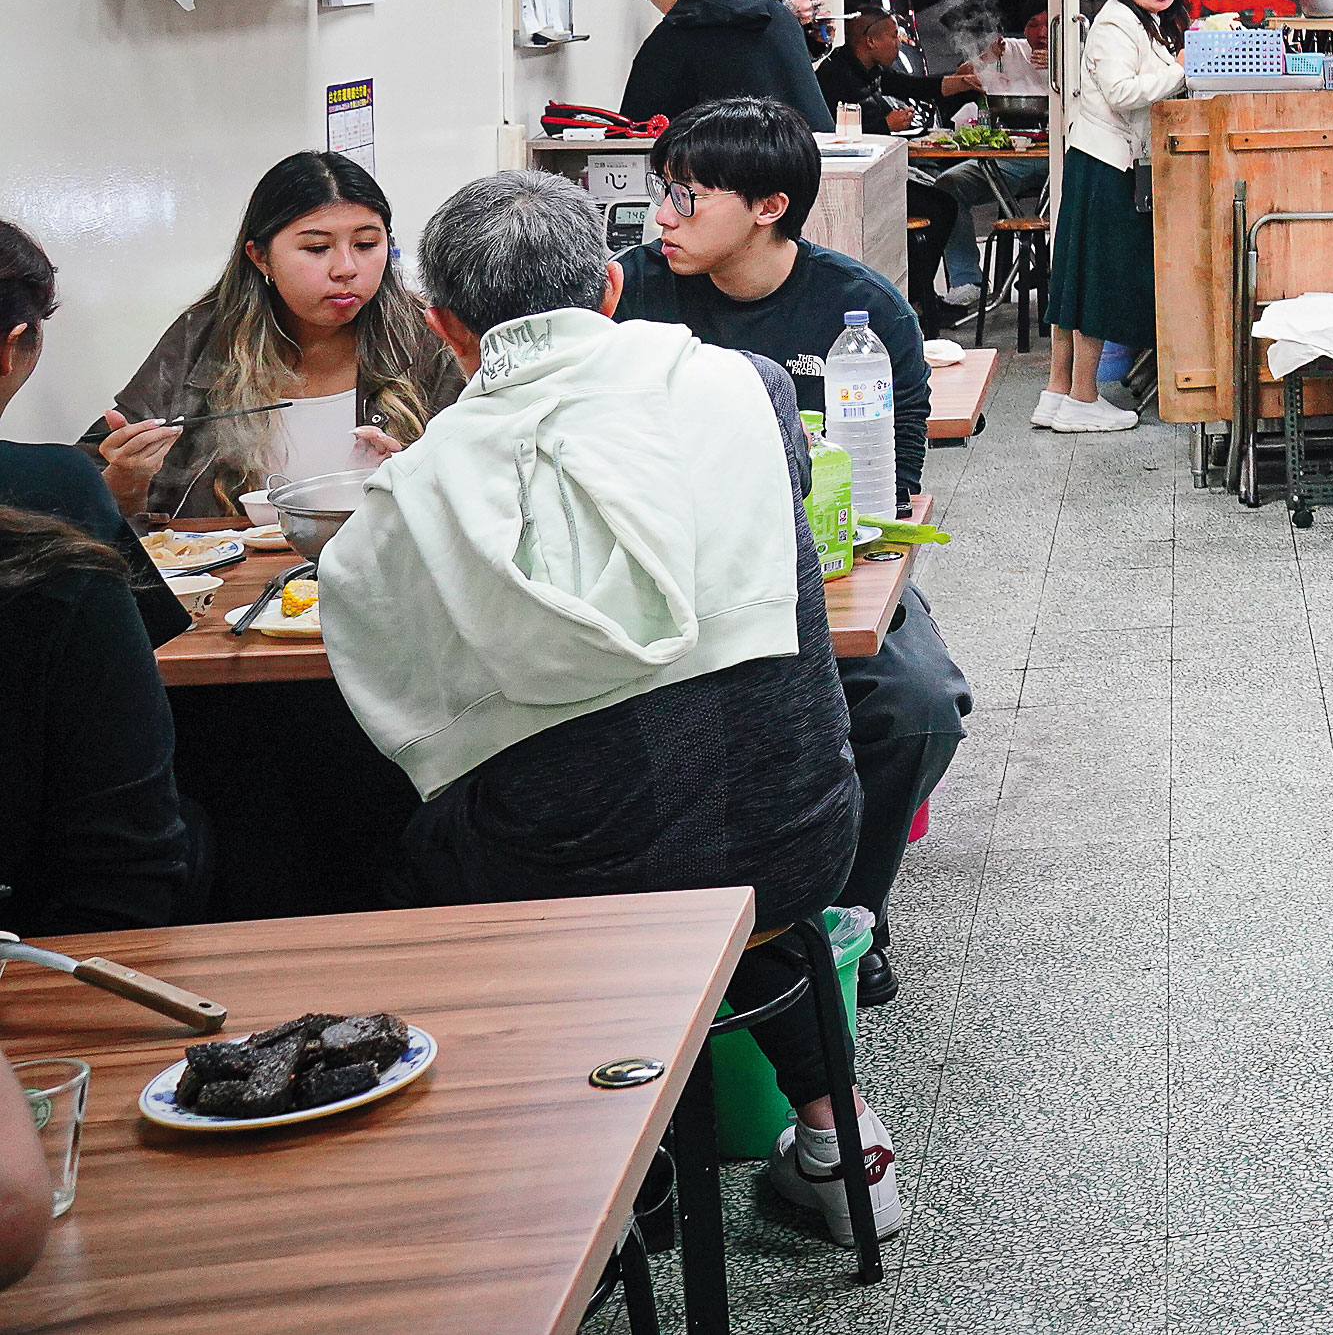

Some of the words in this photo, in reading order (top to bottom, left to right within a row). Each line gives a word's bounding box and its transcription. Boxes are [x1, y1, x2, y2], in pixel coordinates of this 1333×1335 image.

[797, 353, 814, 363] THE
[786, 359, 813, 370] NORTH
[791, 366, 813, 376] FACE
[869, 1164, 881, 1176] IR
